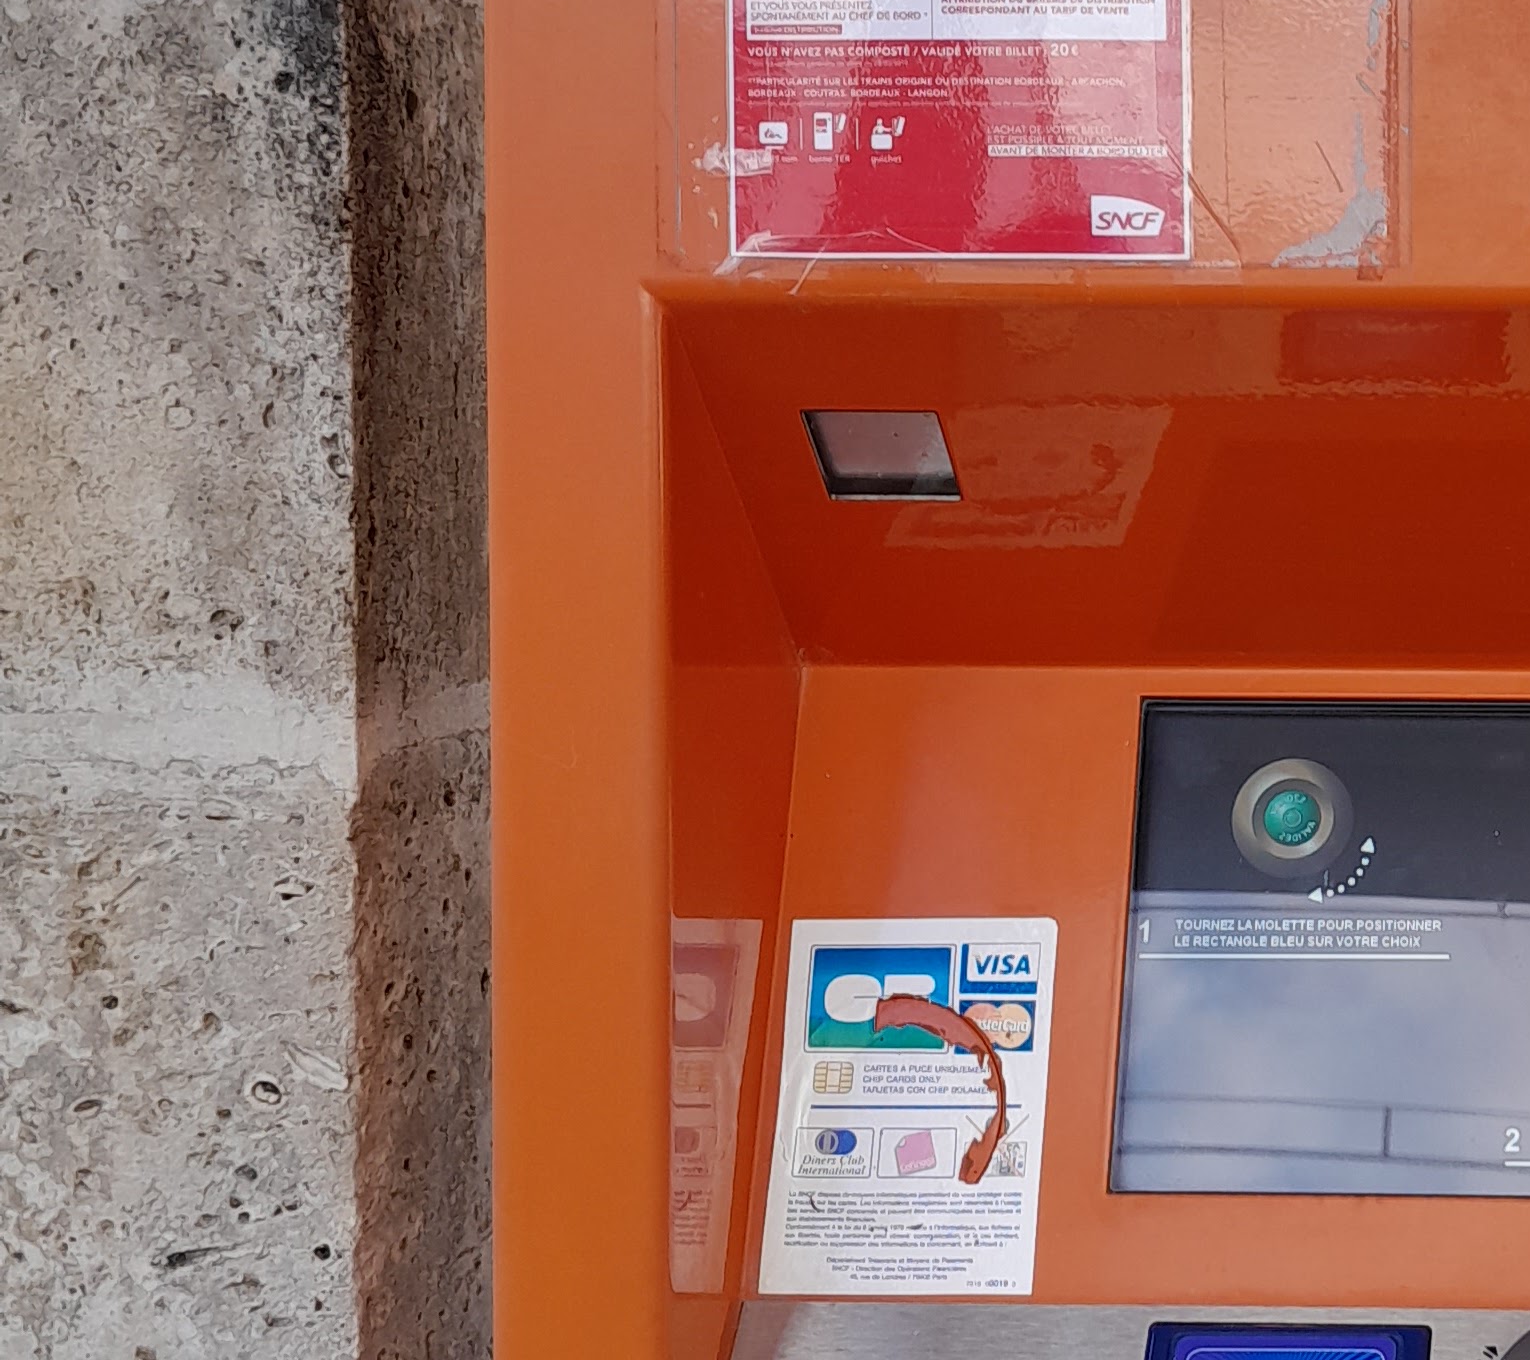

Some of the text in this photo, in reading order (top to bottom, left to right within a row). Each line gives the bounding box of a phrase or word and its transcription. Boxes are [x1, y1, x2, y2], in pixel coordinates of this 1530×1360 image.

[748, 48, 778, 58] VOUS
[781, 47, 821, 57] N'AVEZ
[824, 47, 844, 56] PAS
[966, 46, 1000, 56] VOTRE
[1095, 212, 1159, 230] SNCF
[1138, 920, 1149, 943] 1
[1176, 919, 1442, 932] TOURNEZ LA MOLETTE POUR POSITIONNER
[1174, 935, 1421, 948] LE RECTANGLE BLEU SUR VOTRE CHOIX
[974, 954, 1031, 976] VISA
[864, 1064, 898, 1073] CARTES
[908, 1064, 932, 1073] PUCE
[863, 1075, 941, 1083] CHIP CARDS ONLY
[907, 1086, 926, 1094] CON
[928, 1086, 949, 1094] CHIP
[1505, 1128, 1520, 1152] 2
[802, 1154, 864, 1165] Diners Club
[798, 1165, 866, 1175] International
